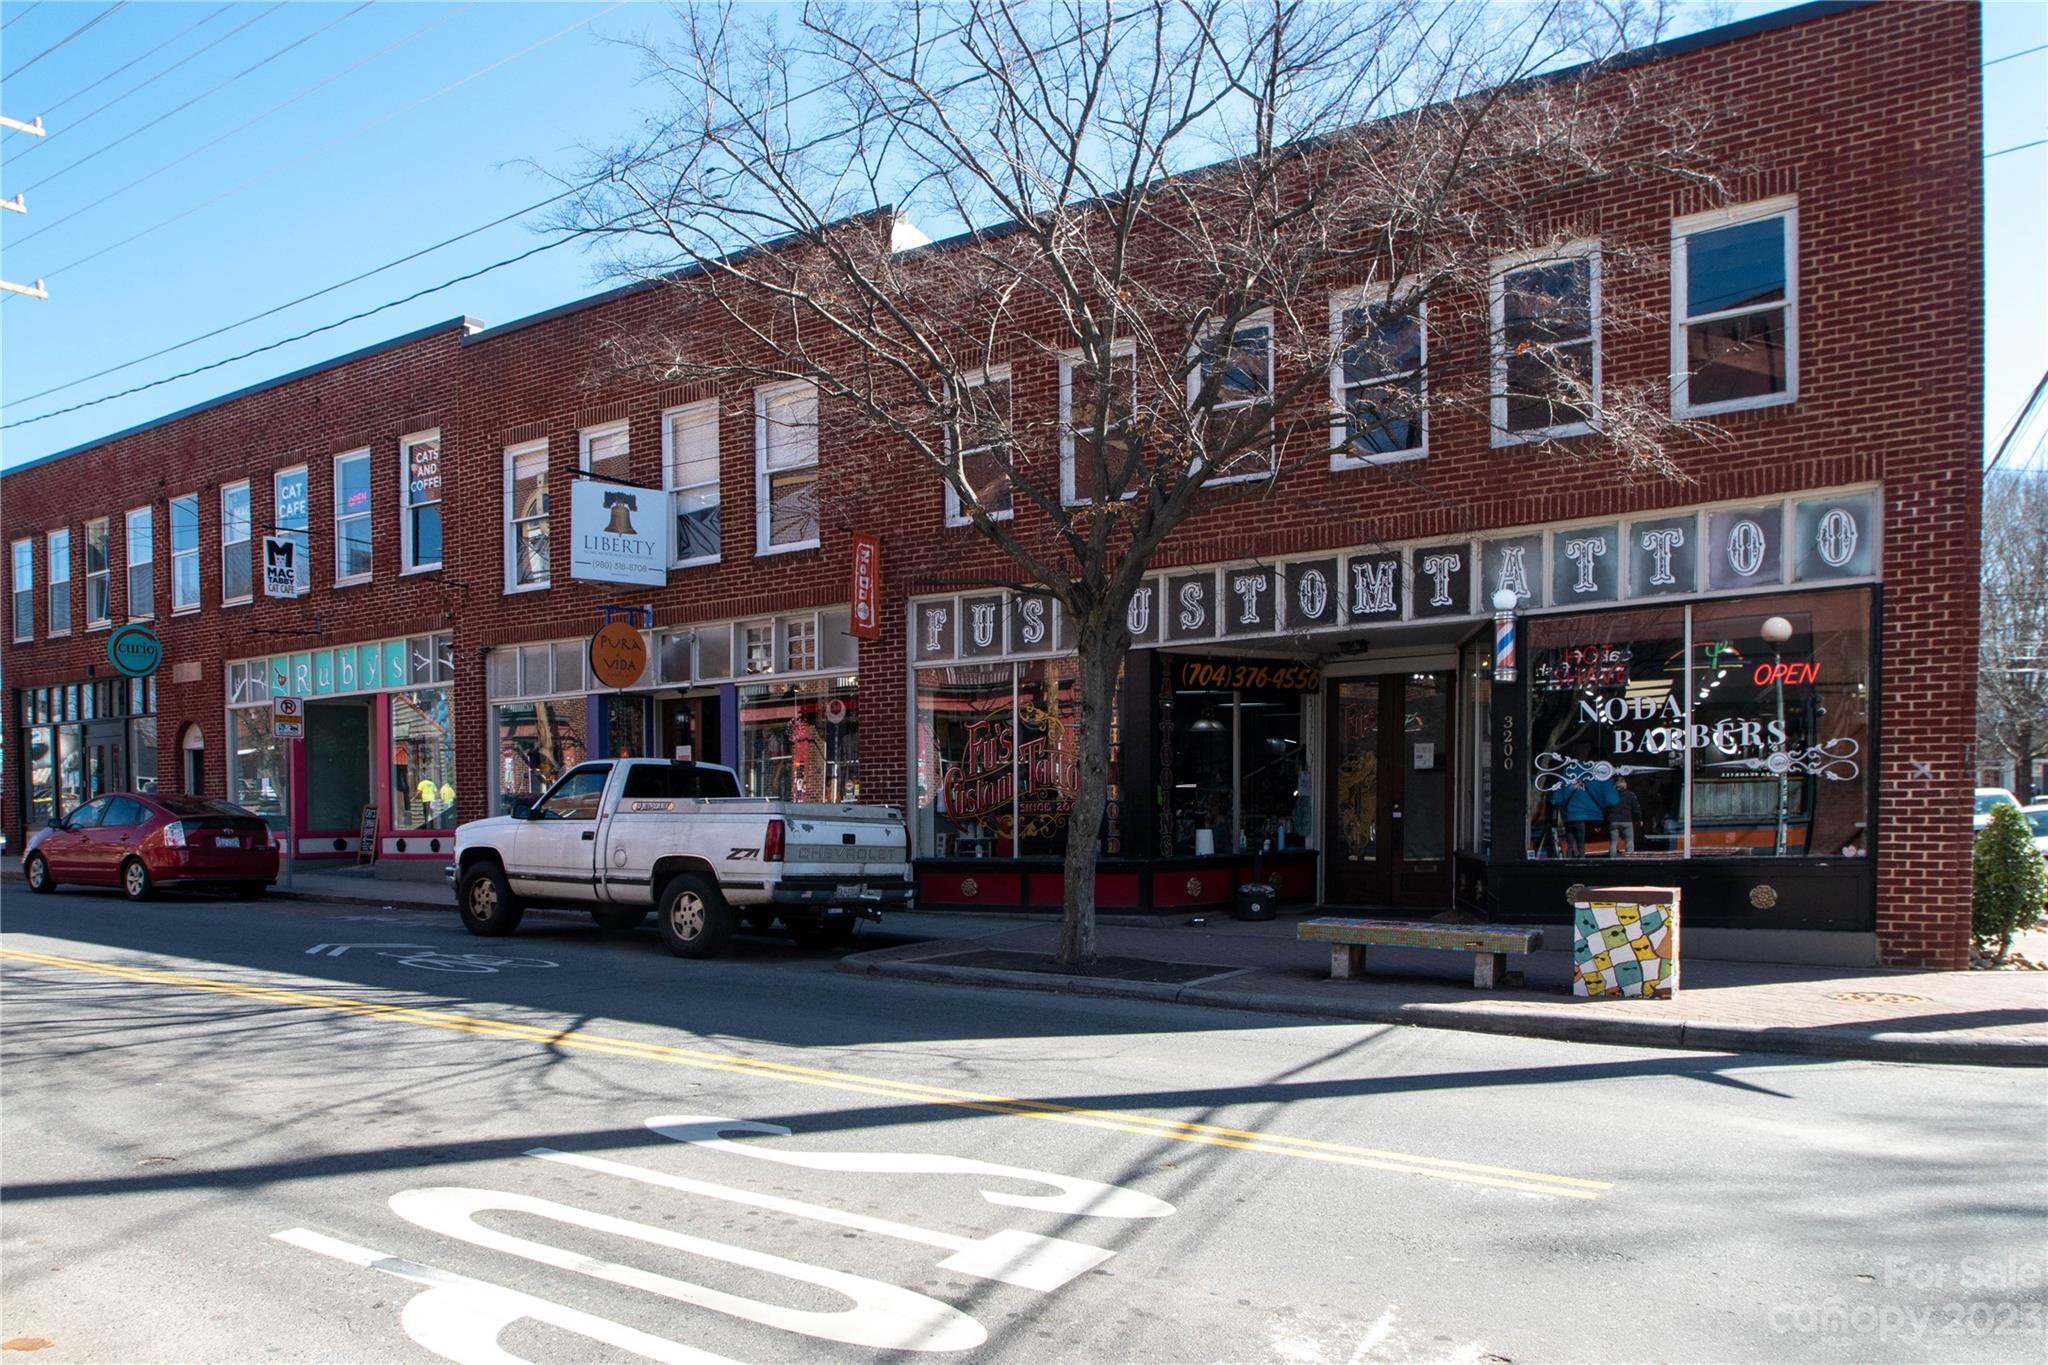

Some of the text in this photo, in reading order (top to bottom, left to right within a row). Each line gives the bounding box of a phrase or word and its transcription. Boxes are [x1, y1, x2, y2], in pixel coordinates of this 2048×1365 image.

[416, 449, 439, 462] CATS
[417, 464, 437, 477] AND
[281, 483, 302, 500] CAT
[279, 502, 306, 518] CAFE
[584, 535, 656, 556] LIBERTY
[1424, 507, 1859, 607] TATTOO
[267, 567, 294, 578] MAC
[268, 576, 295, 585] TABBY
[268, 583, 295, 593] CAT CAFE
[1128, 559, 1398, 635] USTOM
[926, 598, 1045, 651] FU'S
[118, 641, 155, 655] curio
[600, 635, 641, 651] PURA
[1753, 663, 1820, 686] OPEN
[1578, 694, 1683, 724] NODA
[1503, 715, 1513, 770] 3200
[1613, 719, 1787, 755] BARBERS
[964, 719, 1013, 777] Fu's
[1018, 737, 1081, 797] Tatto
[944, 766, 1014, 833] Custom
[1019, 803, 1050, 813] SINCE
[726, 847, 761, 861] Z71
[798, 846, 895, 860] CHEVROLET
